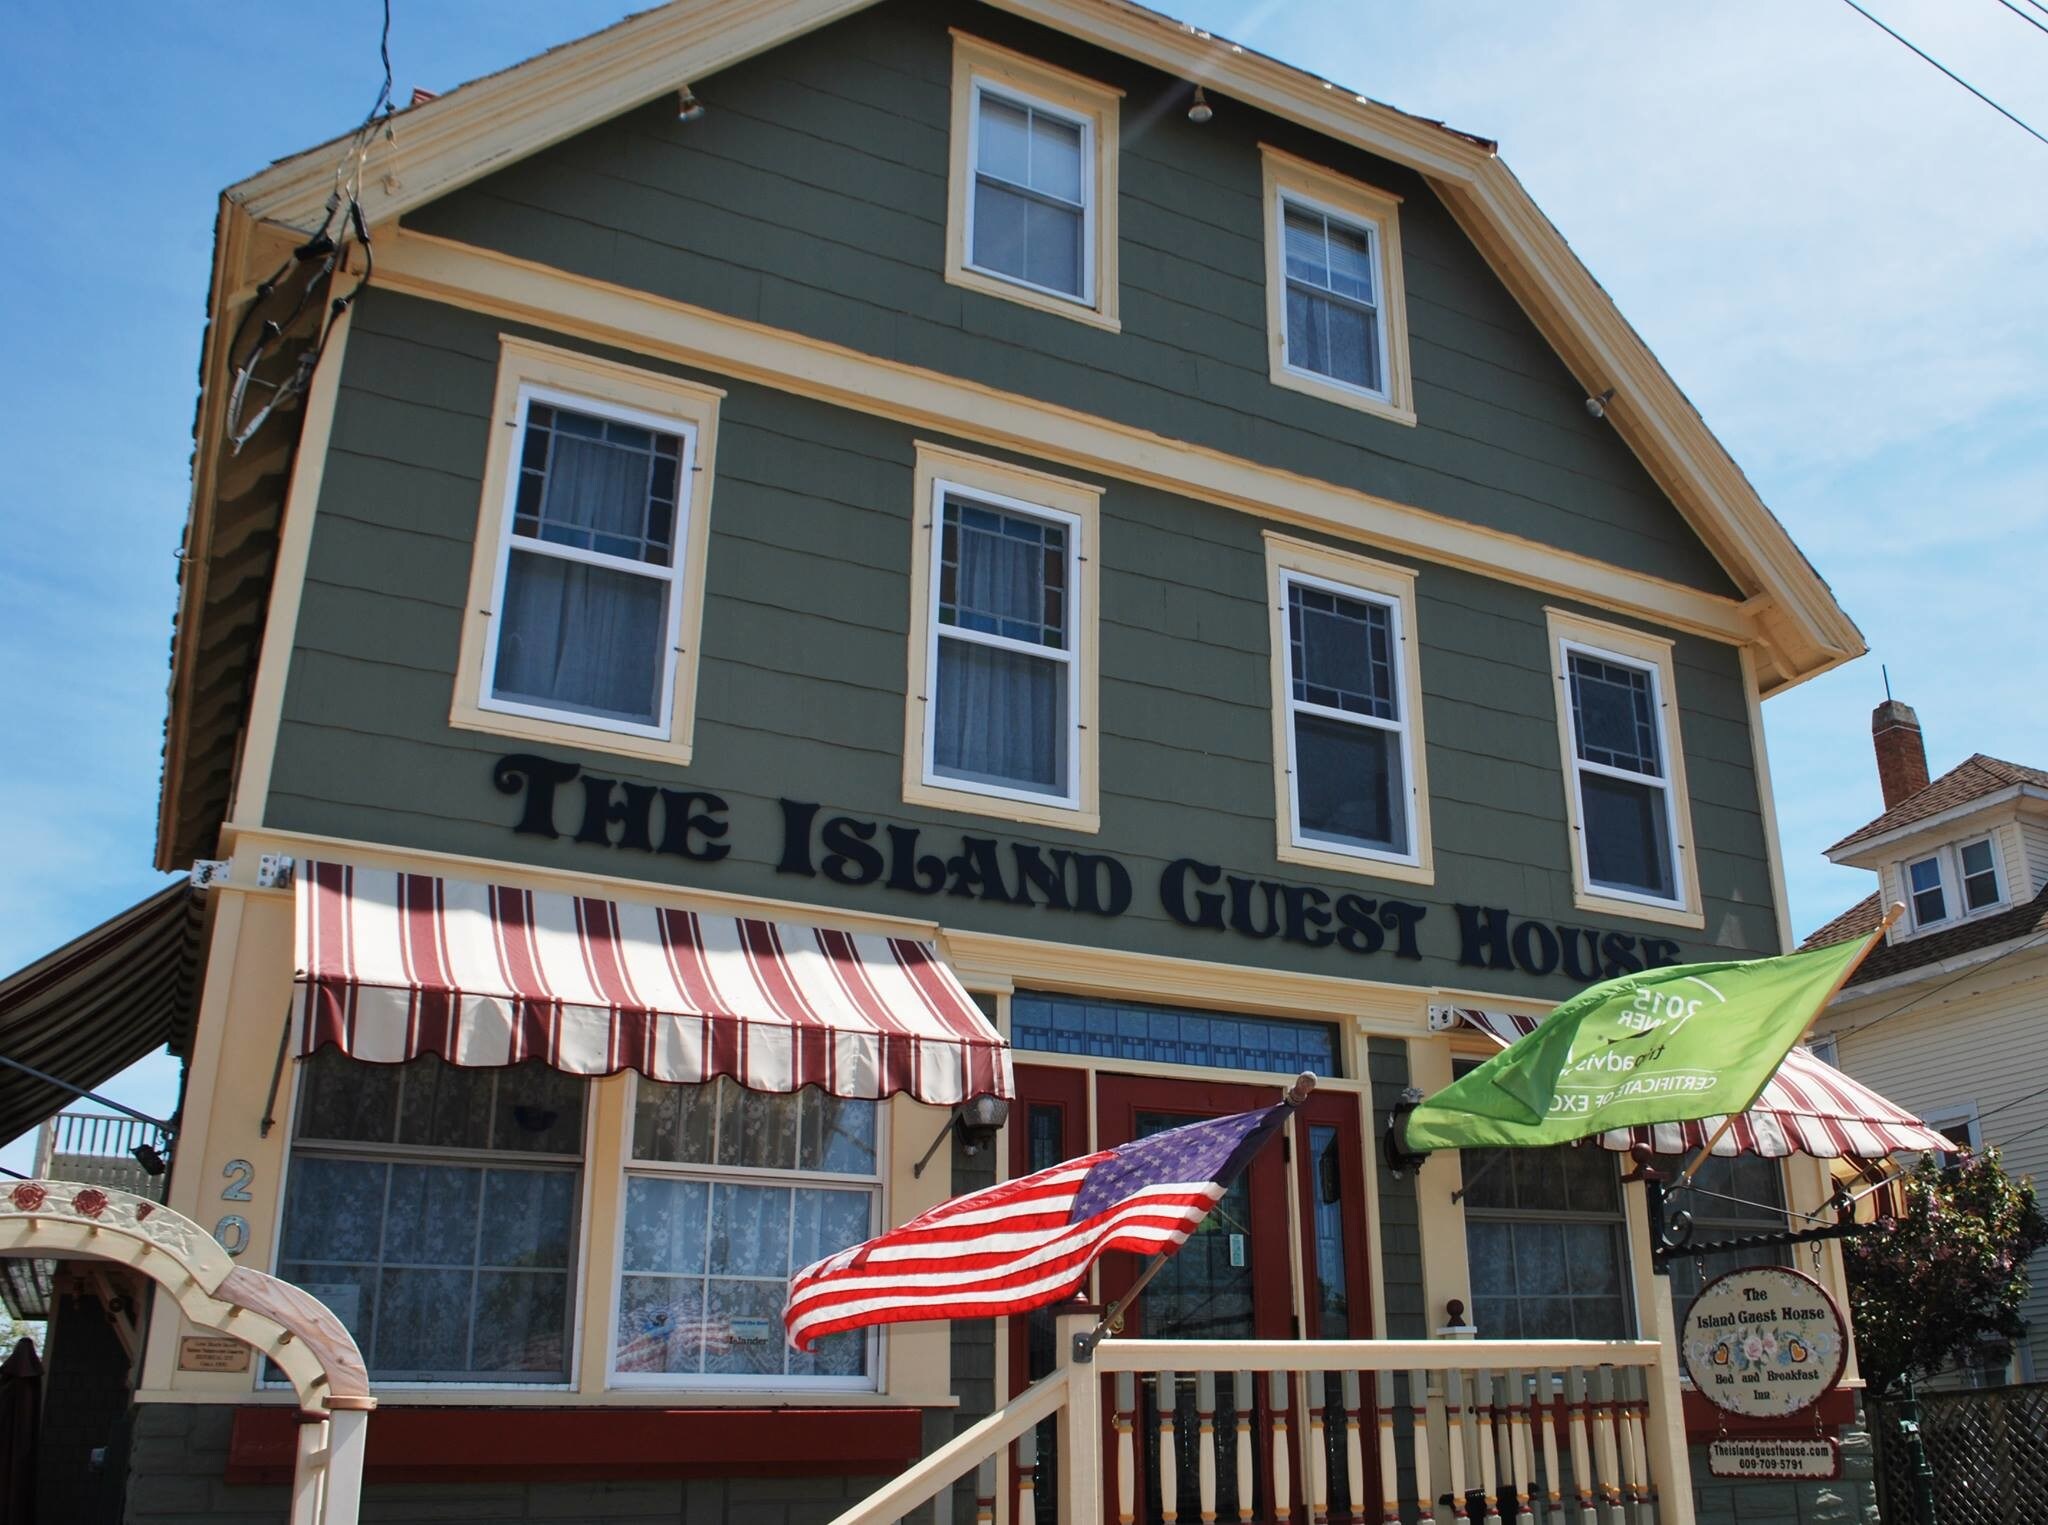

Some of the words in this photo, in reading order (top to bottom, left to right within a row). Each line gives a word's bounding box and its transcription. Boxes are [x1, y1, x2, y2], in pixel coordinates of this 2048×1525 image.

[493, 753, 731, 862] THE
[775, 797, 1133, 917] ISLAND
[1160, 857, 1426, 961] GUEST
[1454, 903, 1682, 982] HOUSE
[1743, 1288, 1768, 1301] The
[1697, 1312, 1736, 1328] Island
[1738, 1309, 1778, 1324] Guest
[1781, 1307, 1825, 1320] House
[1715, 1374, 1734, 1384] Bed
[1742, 1372, 1760, 1383] and
[1767, 1369, 1820, 1381] Breakfast
[1753, 1390, 1770, 1400] Inn
[1714, 1445, 1829, 1458] Theislandguesthouse.com
